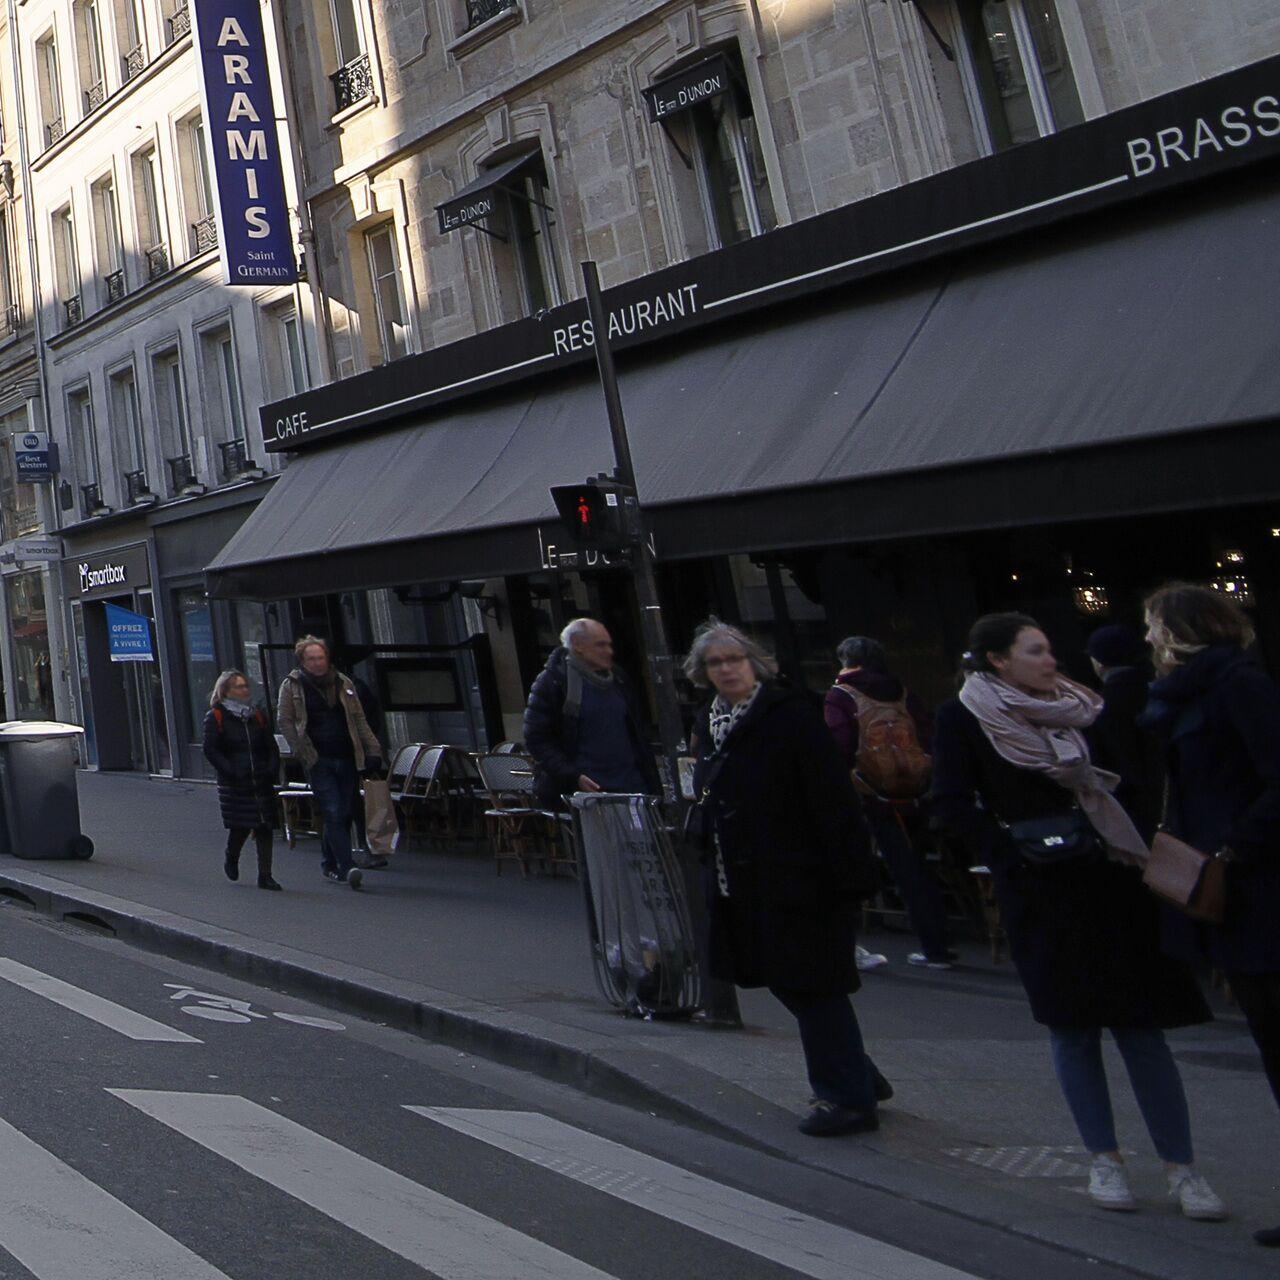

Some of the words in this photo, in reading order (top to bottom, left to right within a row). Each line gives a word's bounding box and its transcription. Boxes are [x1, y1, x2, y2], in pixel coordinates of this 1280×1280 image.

[678, 76, 720, 105] D'UNION
[217, 17, 271, 239] ARAMIS
[1127, 96, 1280, 177] BRASS
[247, 251, 275, 261] Saint
[238, 265, 289, 277] GERMAIN
[553, 284, 698, 356] RESAURANT
[276, 412, 308, 439] CAFE
[88, 563, 126, 587] smartbox
[112, 624, 142, 632] OFFREZ
[120, 640, 141, 648] VIVRE
